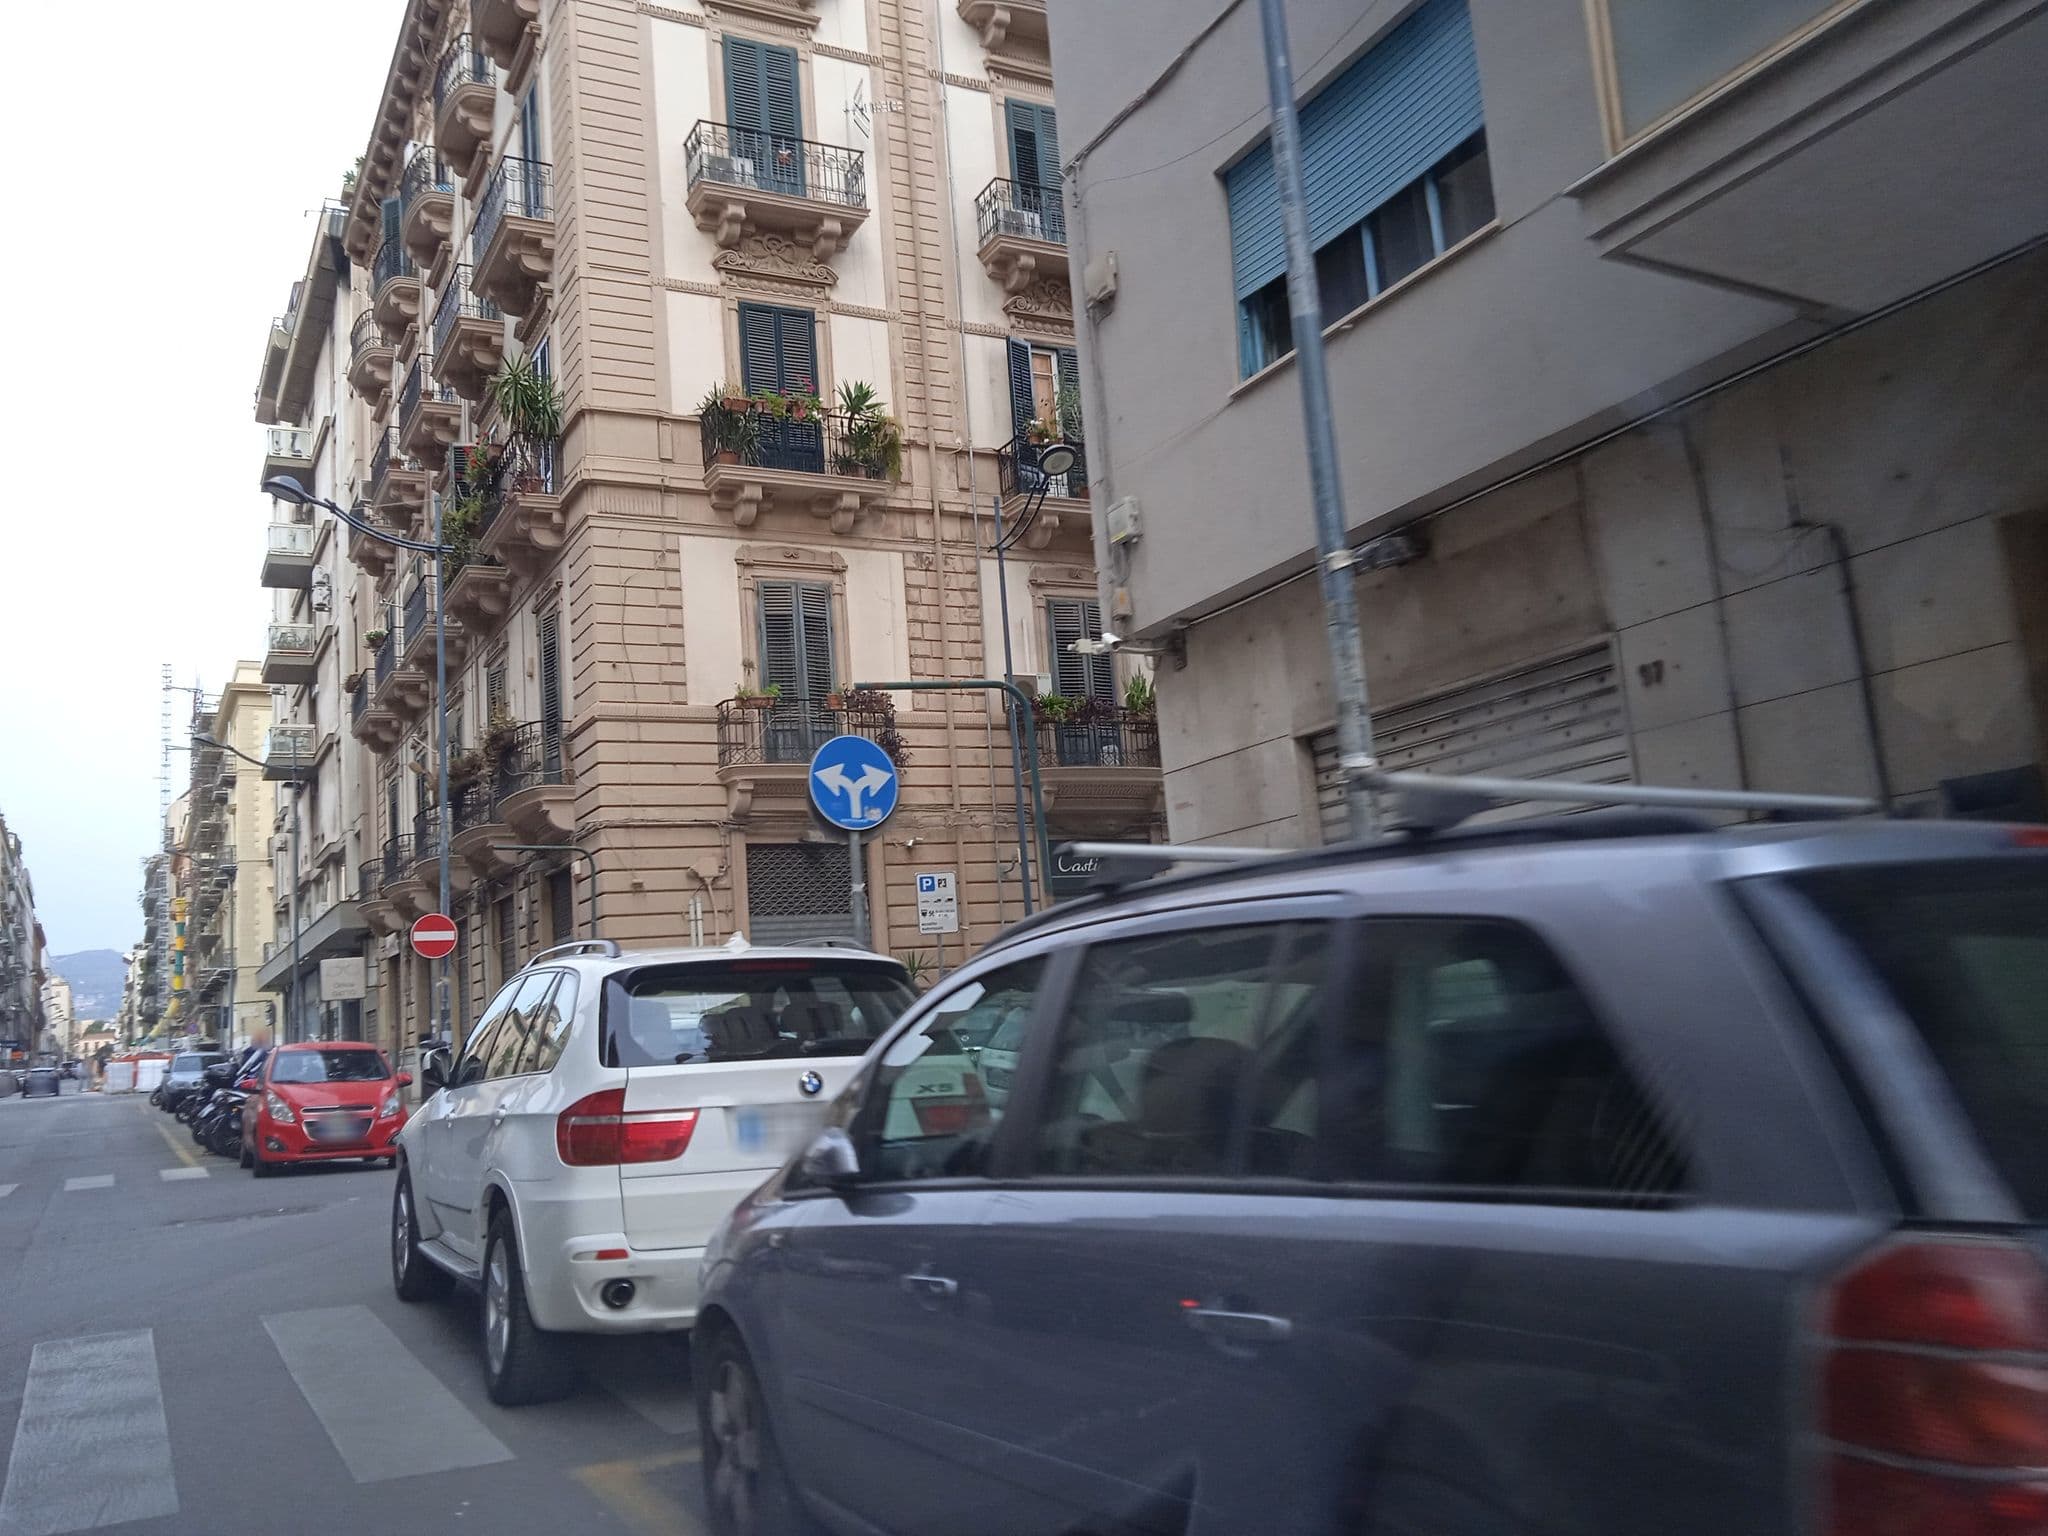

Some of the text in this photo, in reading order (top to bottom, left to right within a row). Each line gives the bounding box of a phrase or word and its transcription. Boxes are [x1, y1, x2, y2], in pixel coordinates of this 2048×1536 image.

[1058, 855, 1100, 872] Casti
[922, 877, 947, 891] P P3
[916, 1083, 953, 1094] X5
